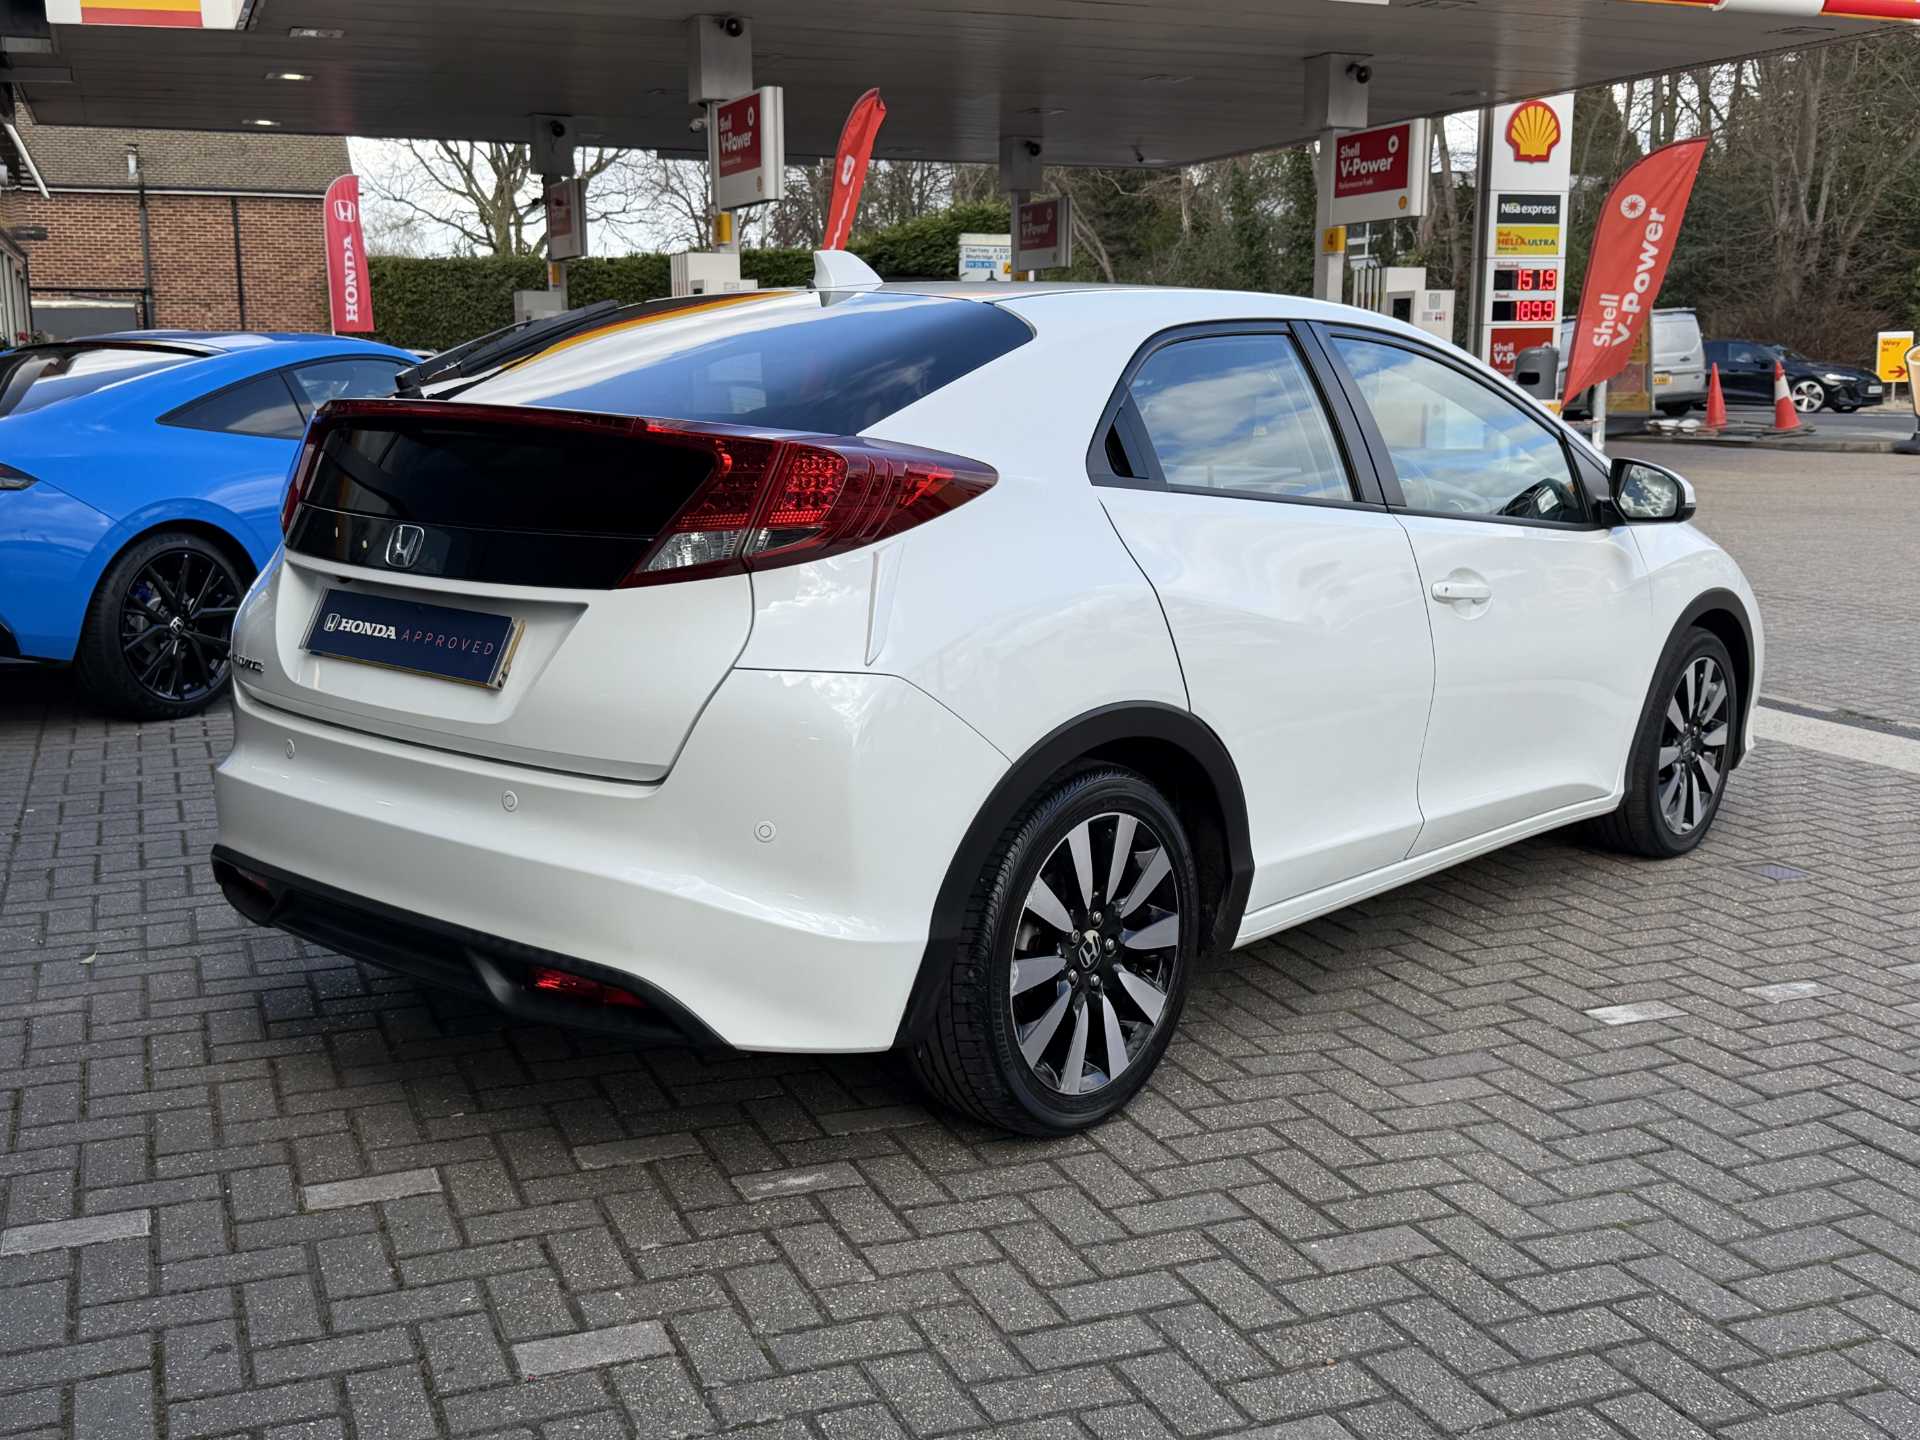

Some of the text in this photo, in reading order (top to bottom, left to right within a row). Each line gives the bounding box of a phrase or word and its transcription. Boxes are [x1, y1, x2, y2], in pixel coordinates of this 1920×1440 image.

[720, 131, 753, 154] V-Power
[1340, 142, 1360, 159] Shell
[1340, 157, 1394, 178] V-Power
[1500, 203, 1557, 216] Nisa express
[1527, 239, 1557, 247] ULTRA
[343, 233, 359, 322] HONDA
[1611, 207, 1666, 347] V-Power
[1593, 293, 1620, 348] Shell
[1493, 342, 1515, 352] Shell
[337, 617, 495, 656] HONDA APPROVED
